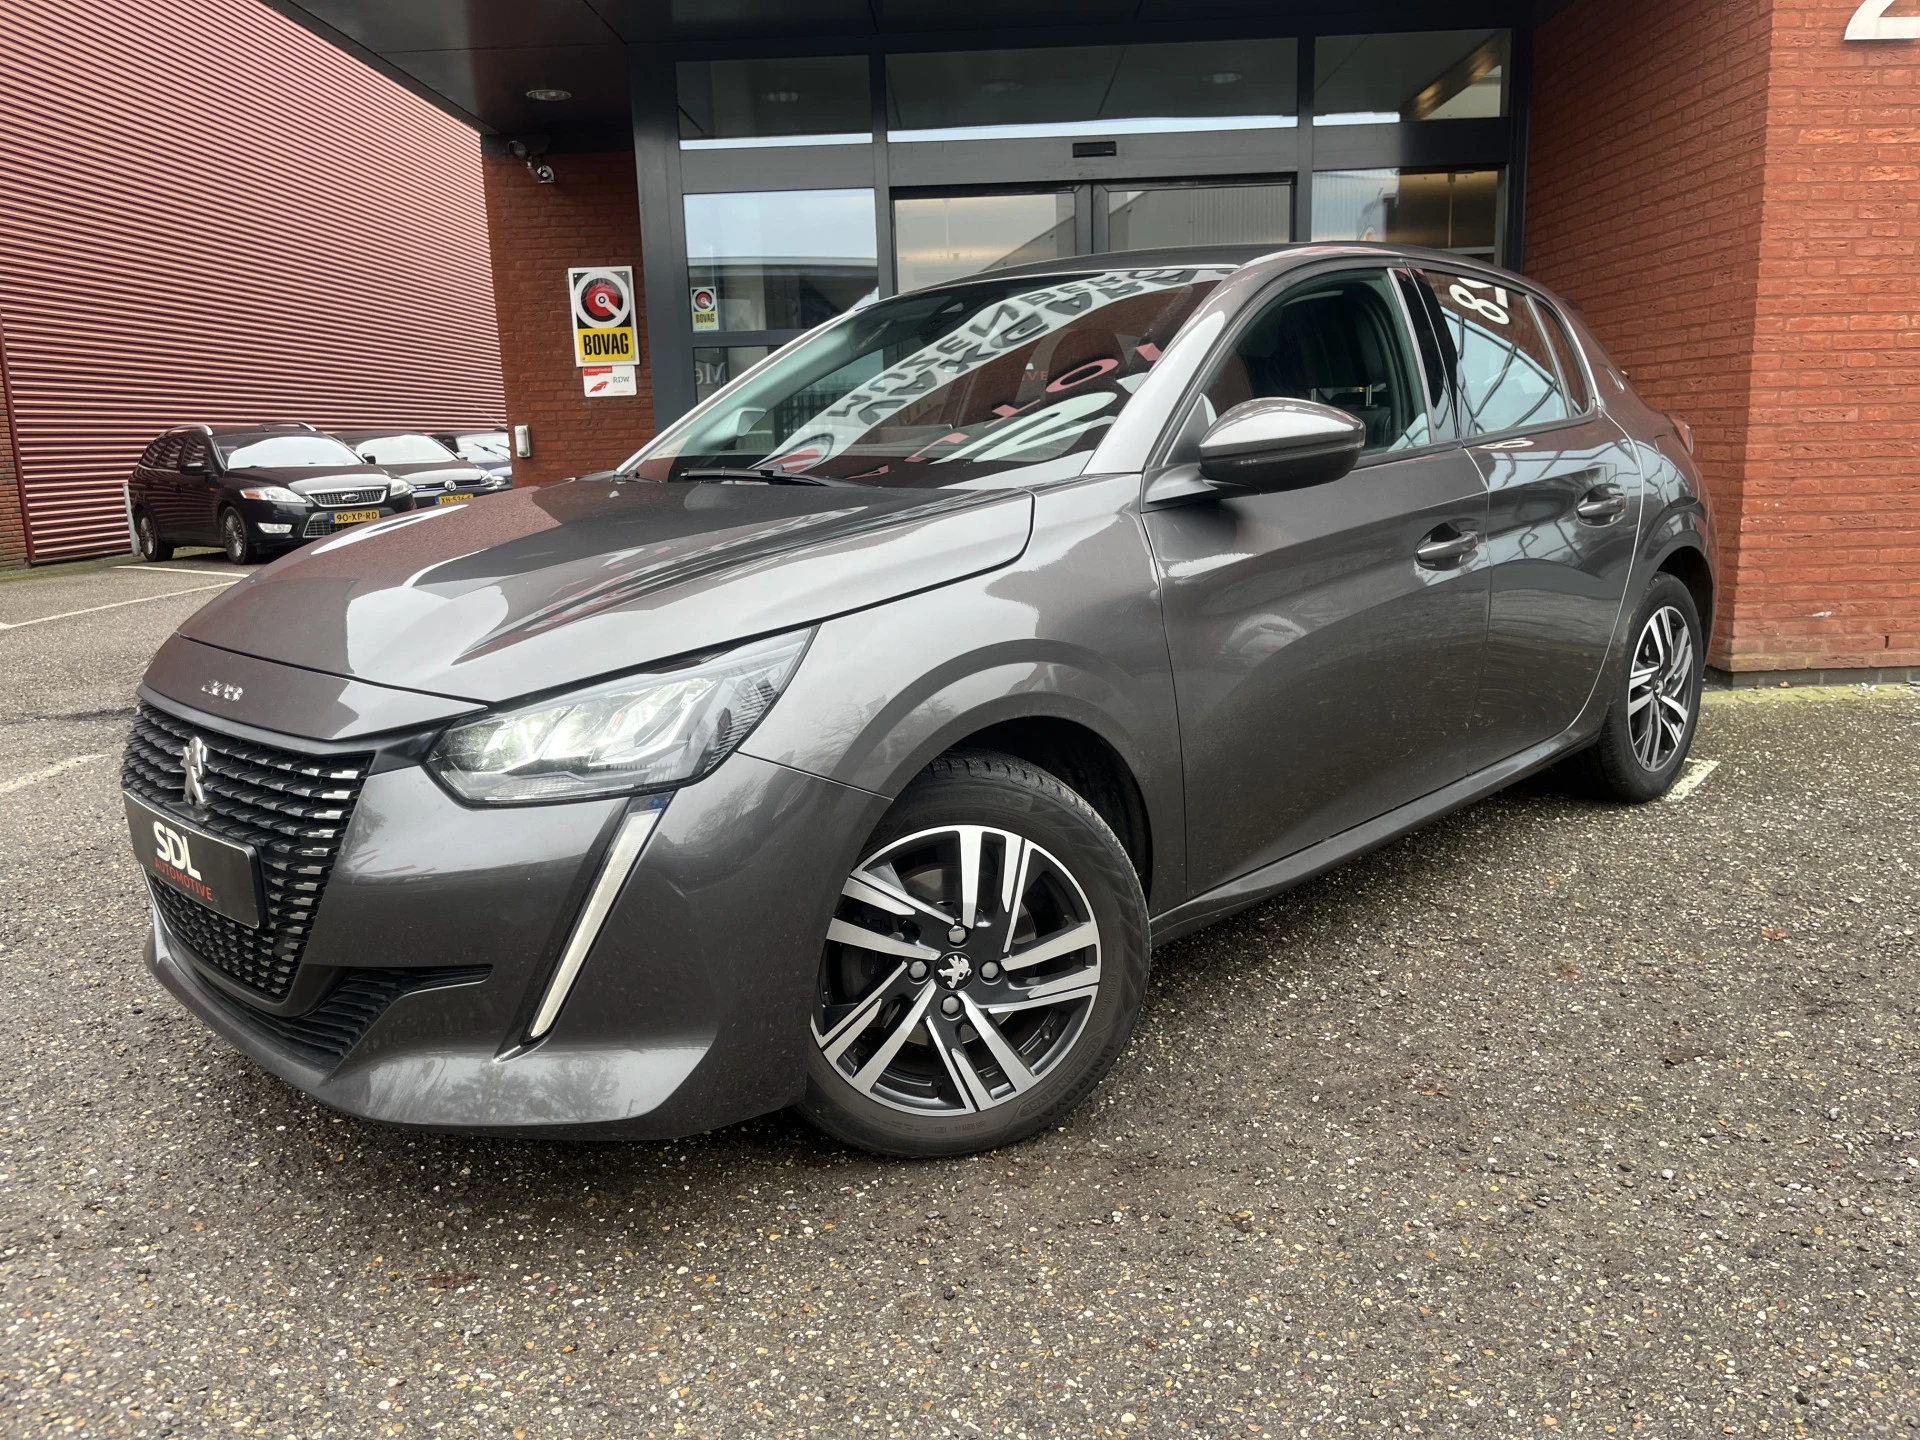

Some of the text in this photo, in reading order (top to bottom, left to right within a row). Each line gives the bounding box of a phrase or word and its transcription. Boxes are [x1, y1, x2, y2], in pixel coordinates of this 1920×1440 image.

[695, 313, 715, 324] BOVAG
[583, 332, 629, 356] BOVAG
[612, 376, 630, 384] RDW
[336, 511, 378, 523] 90-XP-RD
[153, 821, 201, 881] SDL
[154, 857, 213, 901] AUTOMOTIVE
